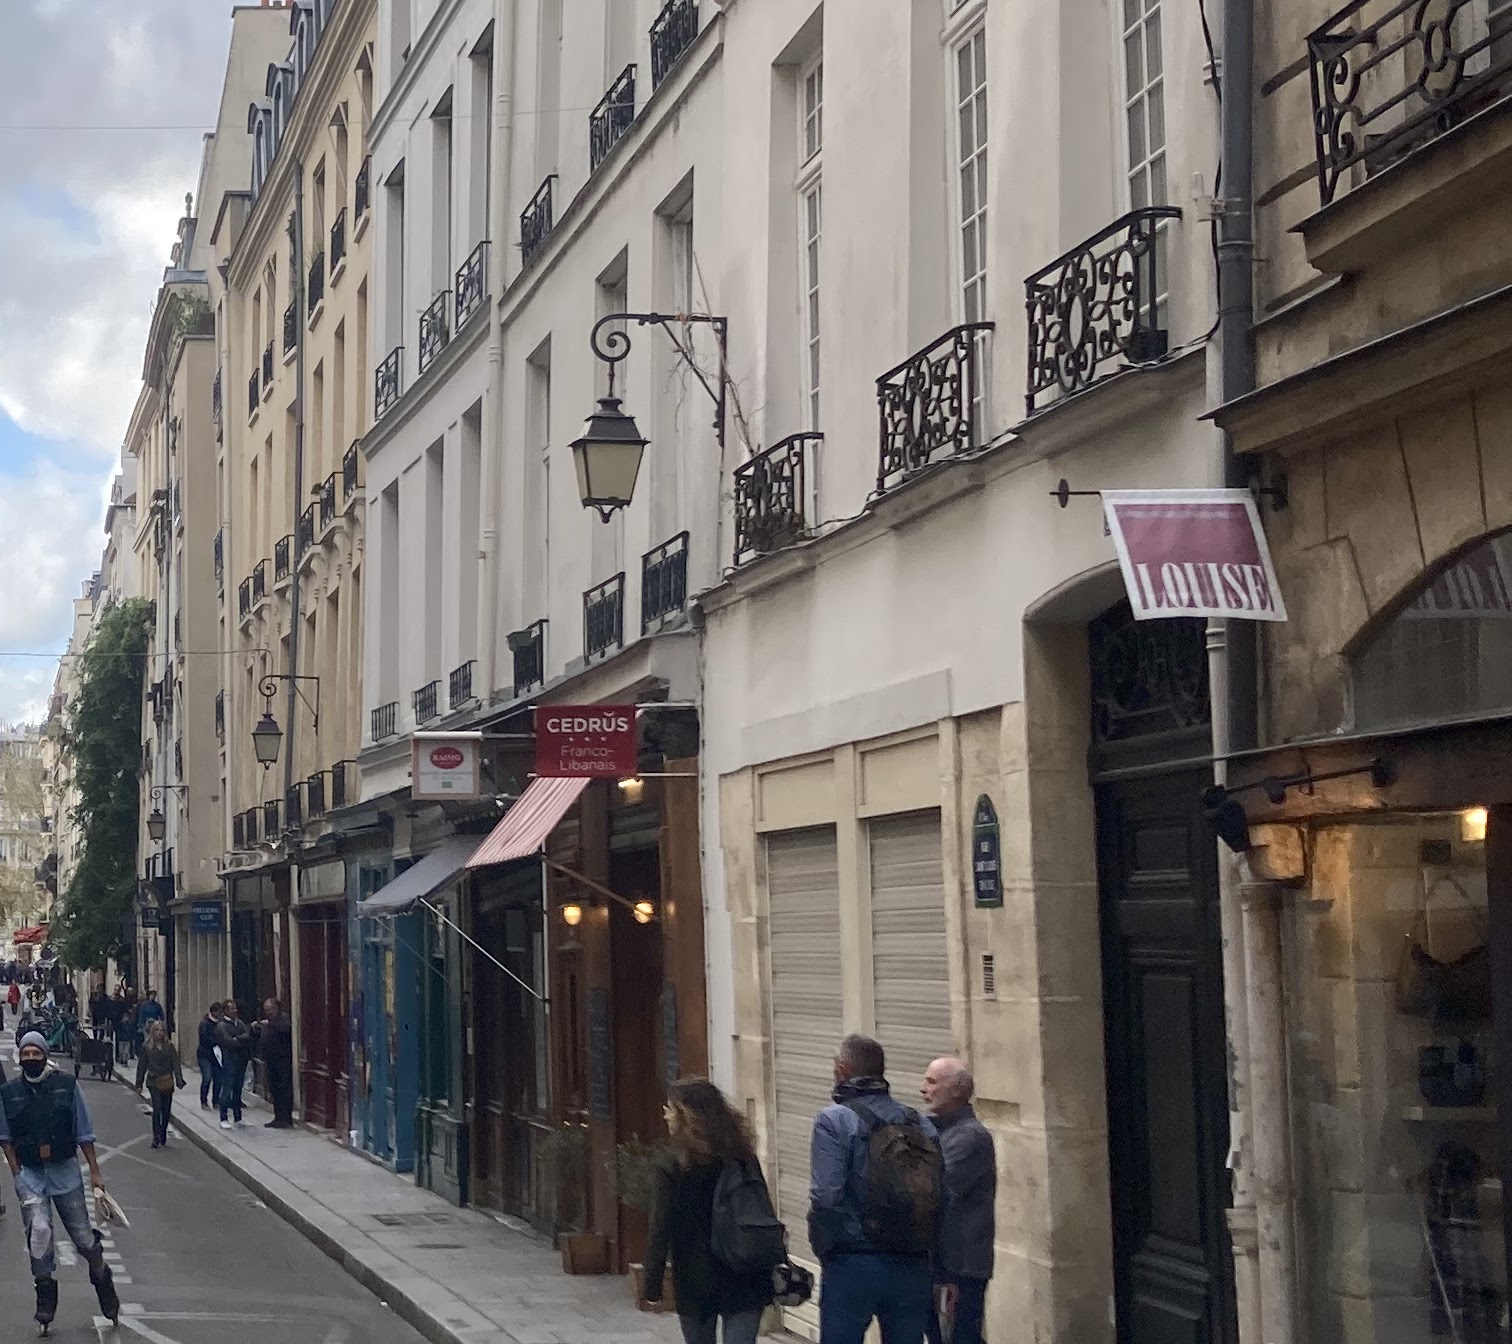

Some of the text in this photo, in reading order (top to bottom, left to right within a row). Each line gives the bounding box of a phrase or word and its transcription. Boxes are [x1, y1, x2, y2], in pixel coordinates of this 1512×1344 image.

[1135, 562, 1275, 612] LOUISE
[560, 745, 614, 757] Franco-
[559, 759, 616, 771] Libanais
